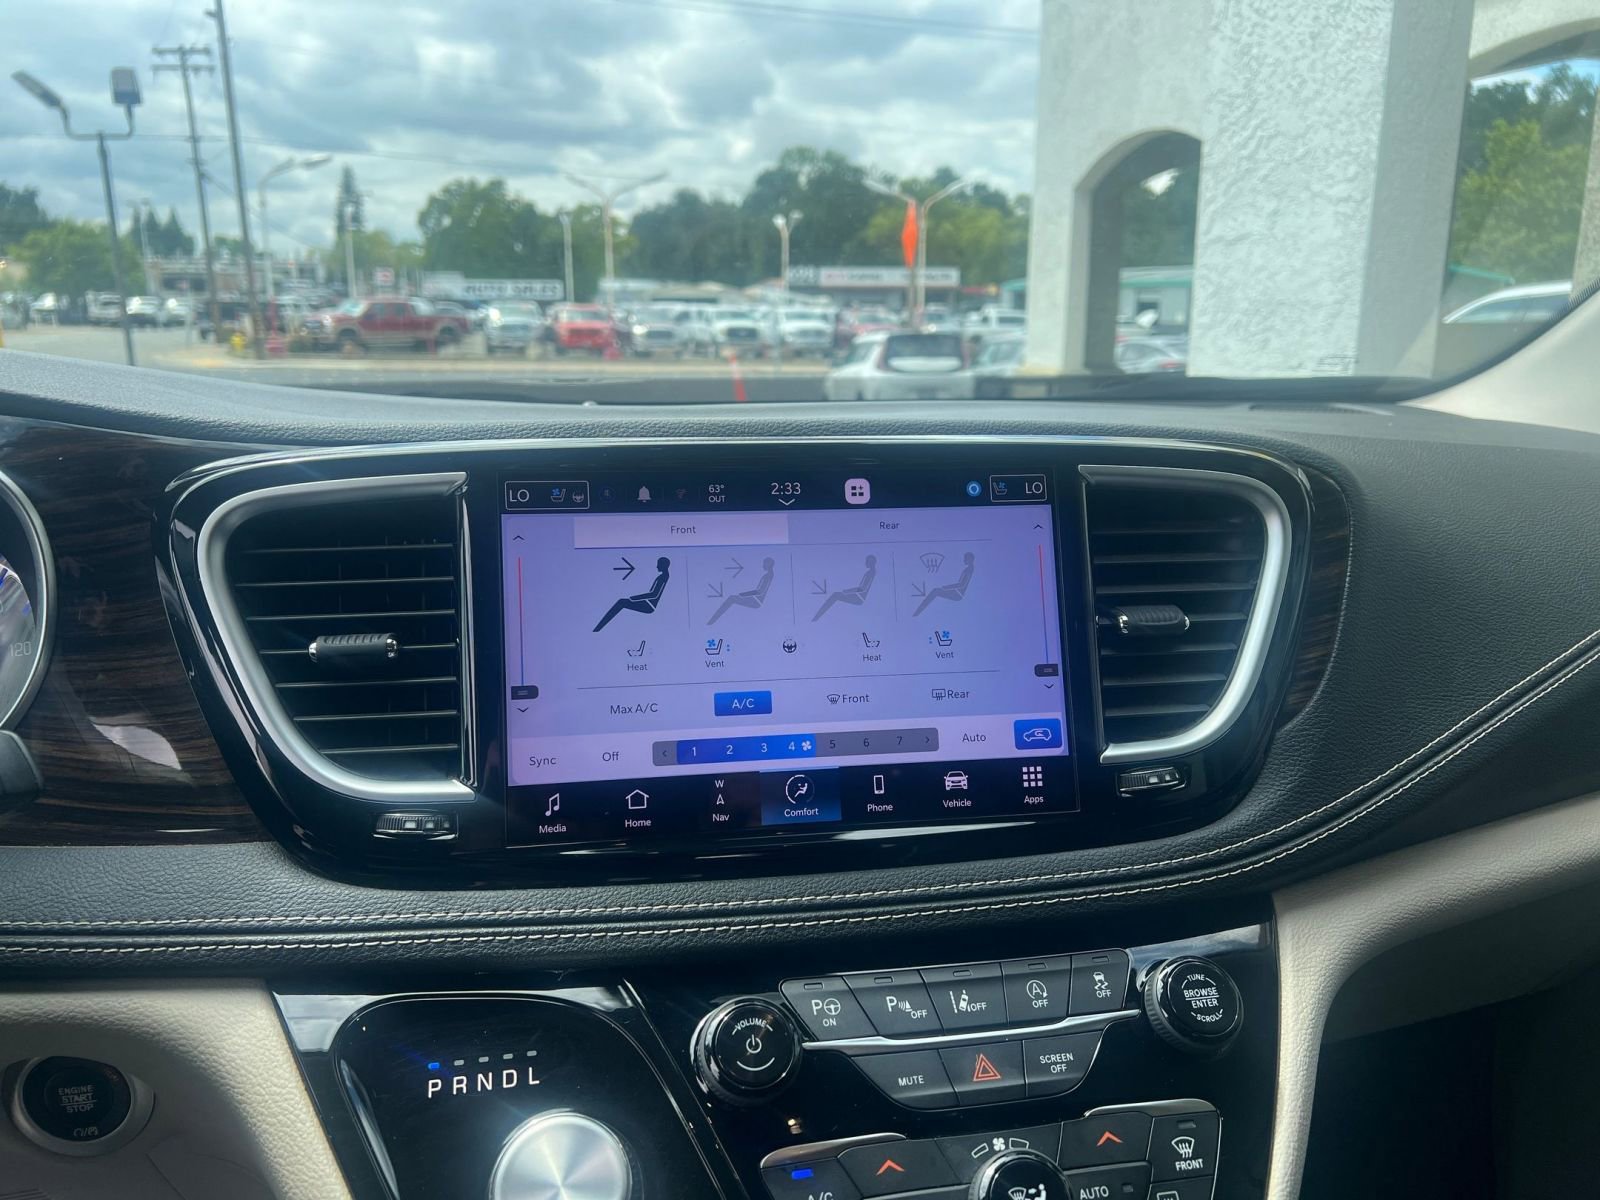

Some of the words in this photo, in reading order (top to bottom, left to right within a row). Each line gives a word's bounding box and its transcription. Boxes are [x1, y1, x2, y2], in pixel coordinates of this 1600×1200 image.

[771, 482, 801, 495] 2:33
[1025, 481, 1043, 494] LO
[509, 489, 530, 502] LO
[708, 495, 725, 503] OUT
[670, 525, 696, 534] Front
[879, 521, 900, 530] Rear
[9, 641, 32, 657] 120
[862, 653, 882, 662] Heat
[935, 651, 954, 659] Vent
[627, 663, 648, 671] Heat
[705, 660, 724, 668] Vent
[842, 693, 870, 703] Front
[947, 690, 969, 699] Rear
[610, 705, 634, 715] Max
[635, 702, 658, 713] A/C
[732, 698, 755, 709] A/C
[962, 732, 987, 742] Auto
[691, 747, 697, 757] 1
[726, 745, 733, 755] 2
[761, 743, 768, 753] 3
[788, 741, 795, 751] 4
[829, 739, 836, 749] 5
[863, 738, 870, 747] 6
[896, 736, 903, 745] 7
[602, 751, 620, 762] Off
[529, 756, 557, 768] Sync
[715, 779, 724, 788] W
[942, 799, 972, 808] Vehicle
[1024, 795, 1044, 804] Apps
[784, 807, 819, 817] Comfort
[867, 803, 893, 813] Phone
[712, 813, 729, 822] Nav
[625, 818, 651, 828] Home
[539, 824, 567, 834] Media
[1187, 973, 1205, 981] TUNE
[1096, 990, 1112, 998] OFF
[1183, 987, 1218, 998] BROWSE
[971, 1002, 987, 1011] OFF
[1032, 999, 1049, 1008] OFF
[1191, 998, 1219, 1009] ENTER
[911, 1009, 928, 1019] OFF
[1196, 1012, 1223, 1022] SCROLL
[735, 1018, 768, 1031] VOLUME
[822, 1018, 837, 1027] ON
[1039, 1052, 1074, 1064] SCREEN
[1050, 1064, 1068, 1074] OFF
[898, 1075, 925, 1086] MUTE
[58, 1085, 94, 1095] ENGINE
[61, 1093, 93, 1103] START
[66, 1104, 94, 1113] STOP
[1175, 1158, 1204, 1171] FRONT
[1079, 1186, 1109, 1200] AUTO
